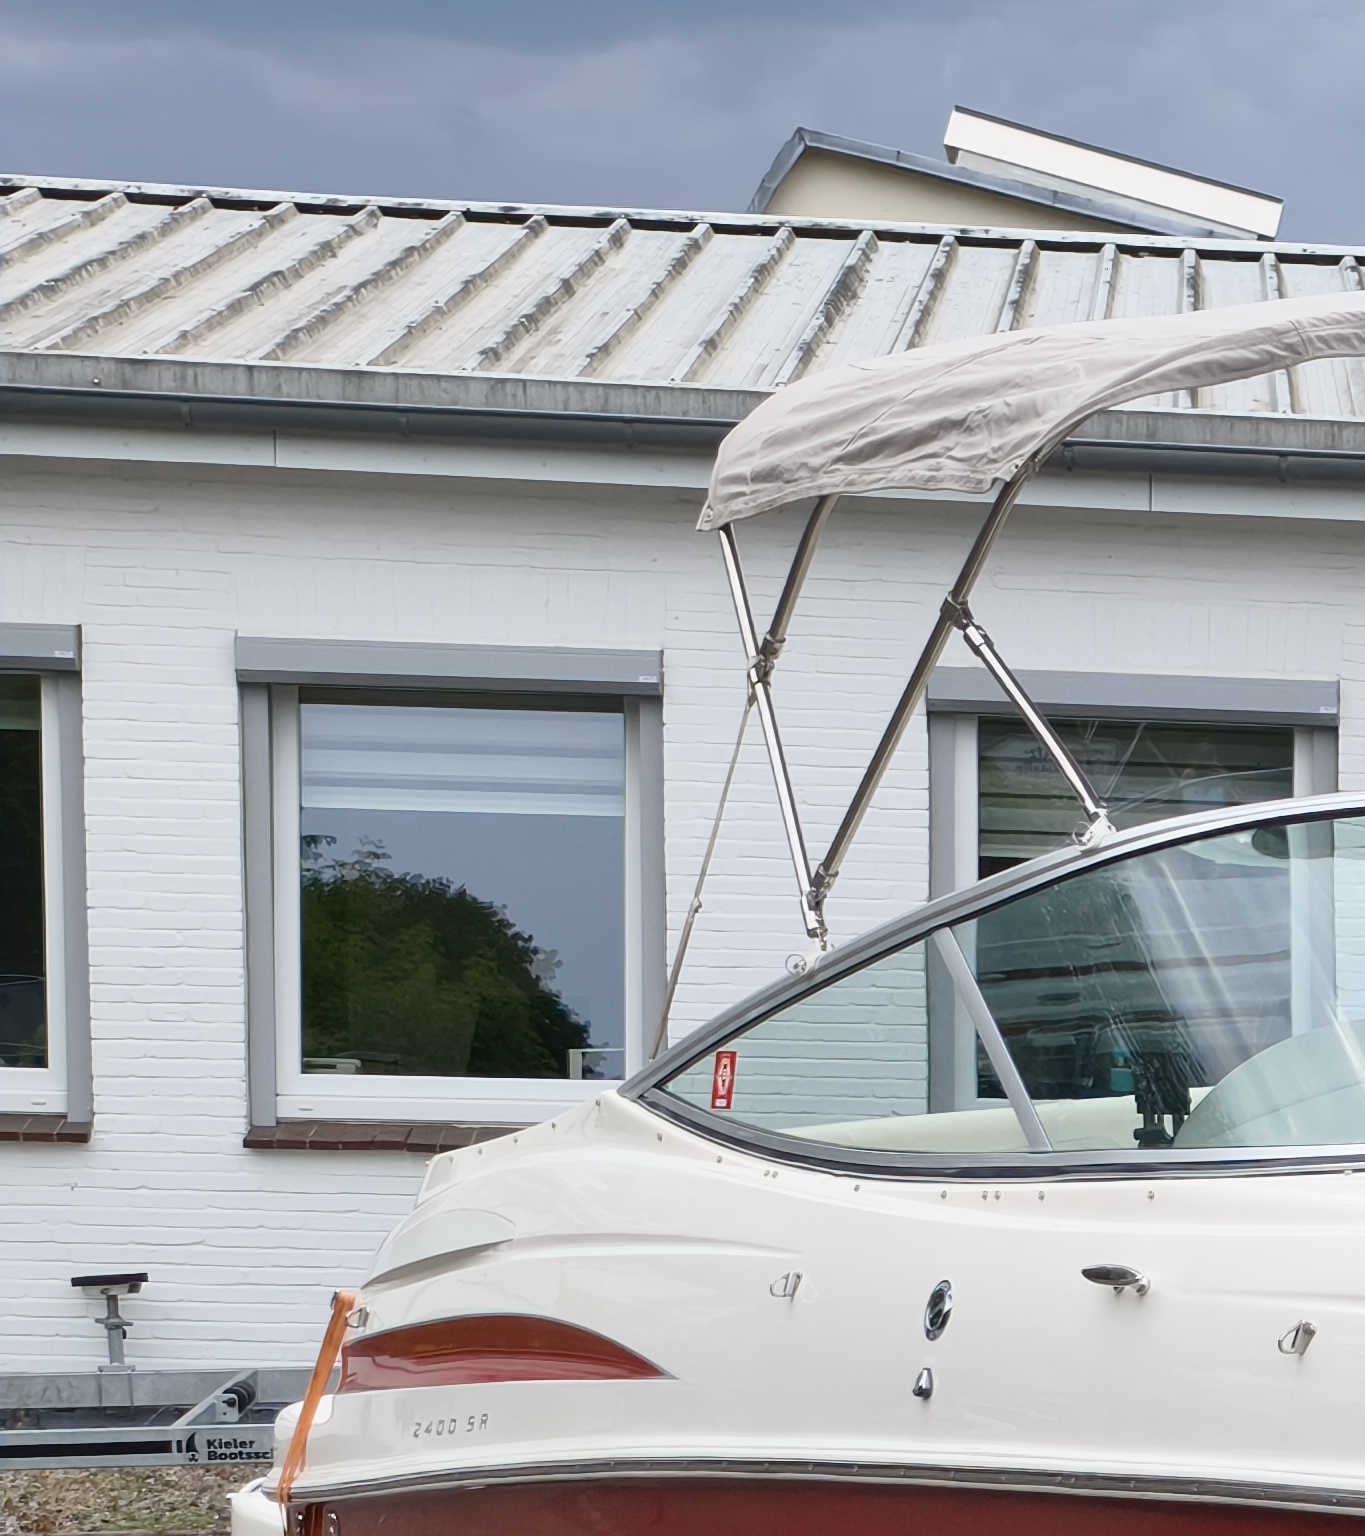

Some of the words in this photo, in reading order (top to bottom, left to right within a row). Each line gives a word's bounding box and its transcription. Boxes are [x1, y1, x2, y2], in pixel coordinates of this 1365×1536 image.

[413, 1418, 457, 1439] 2400
[465, 1413, 489, 1433] SR
[206, 1438, 256, 1450] Kieler
